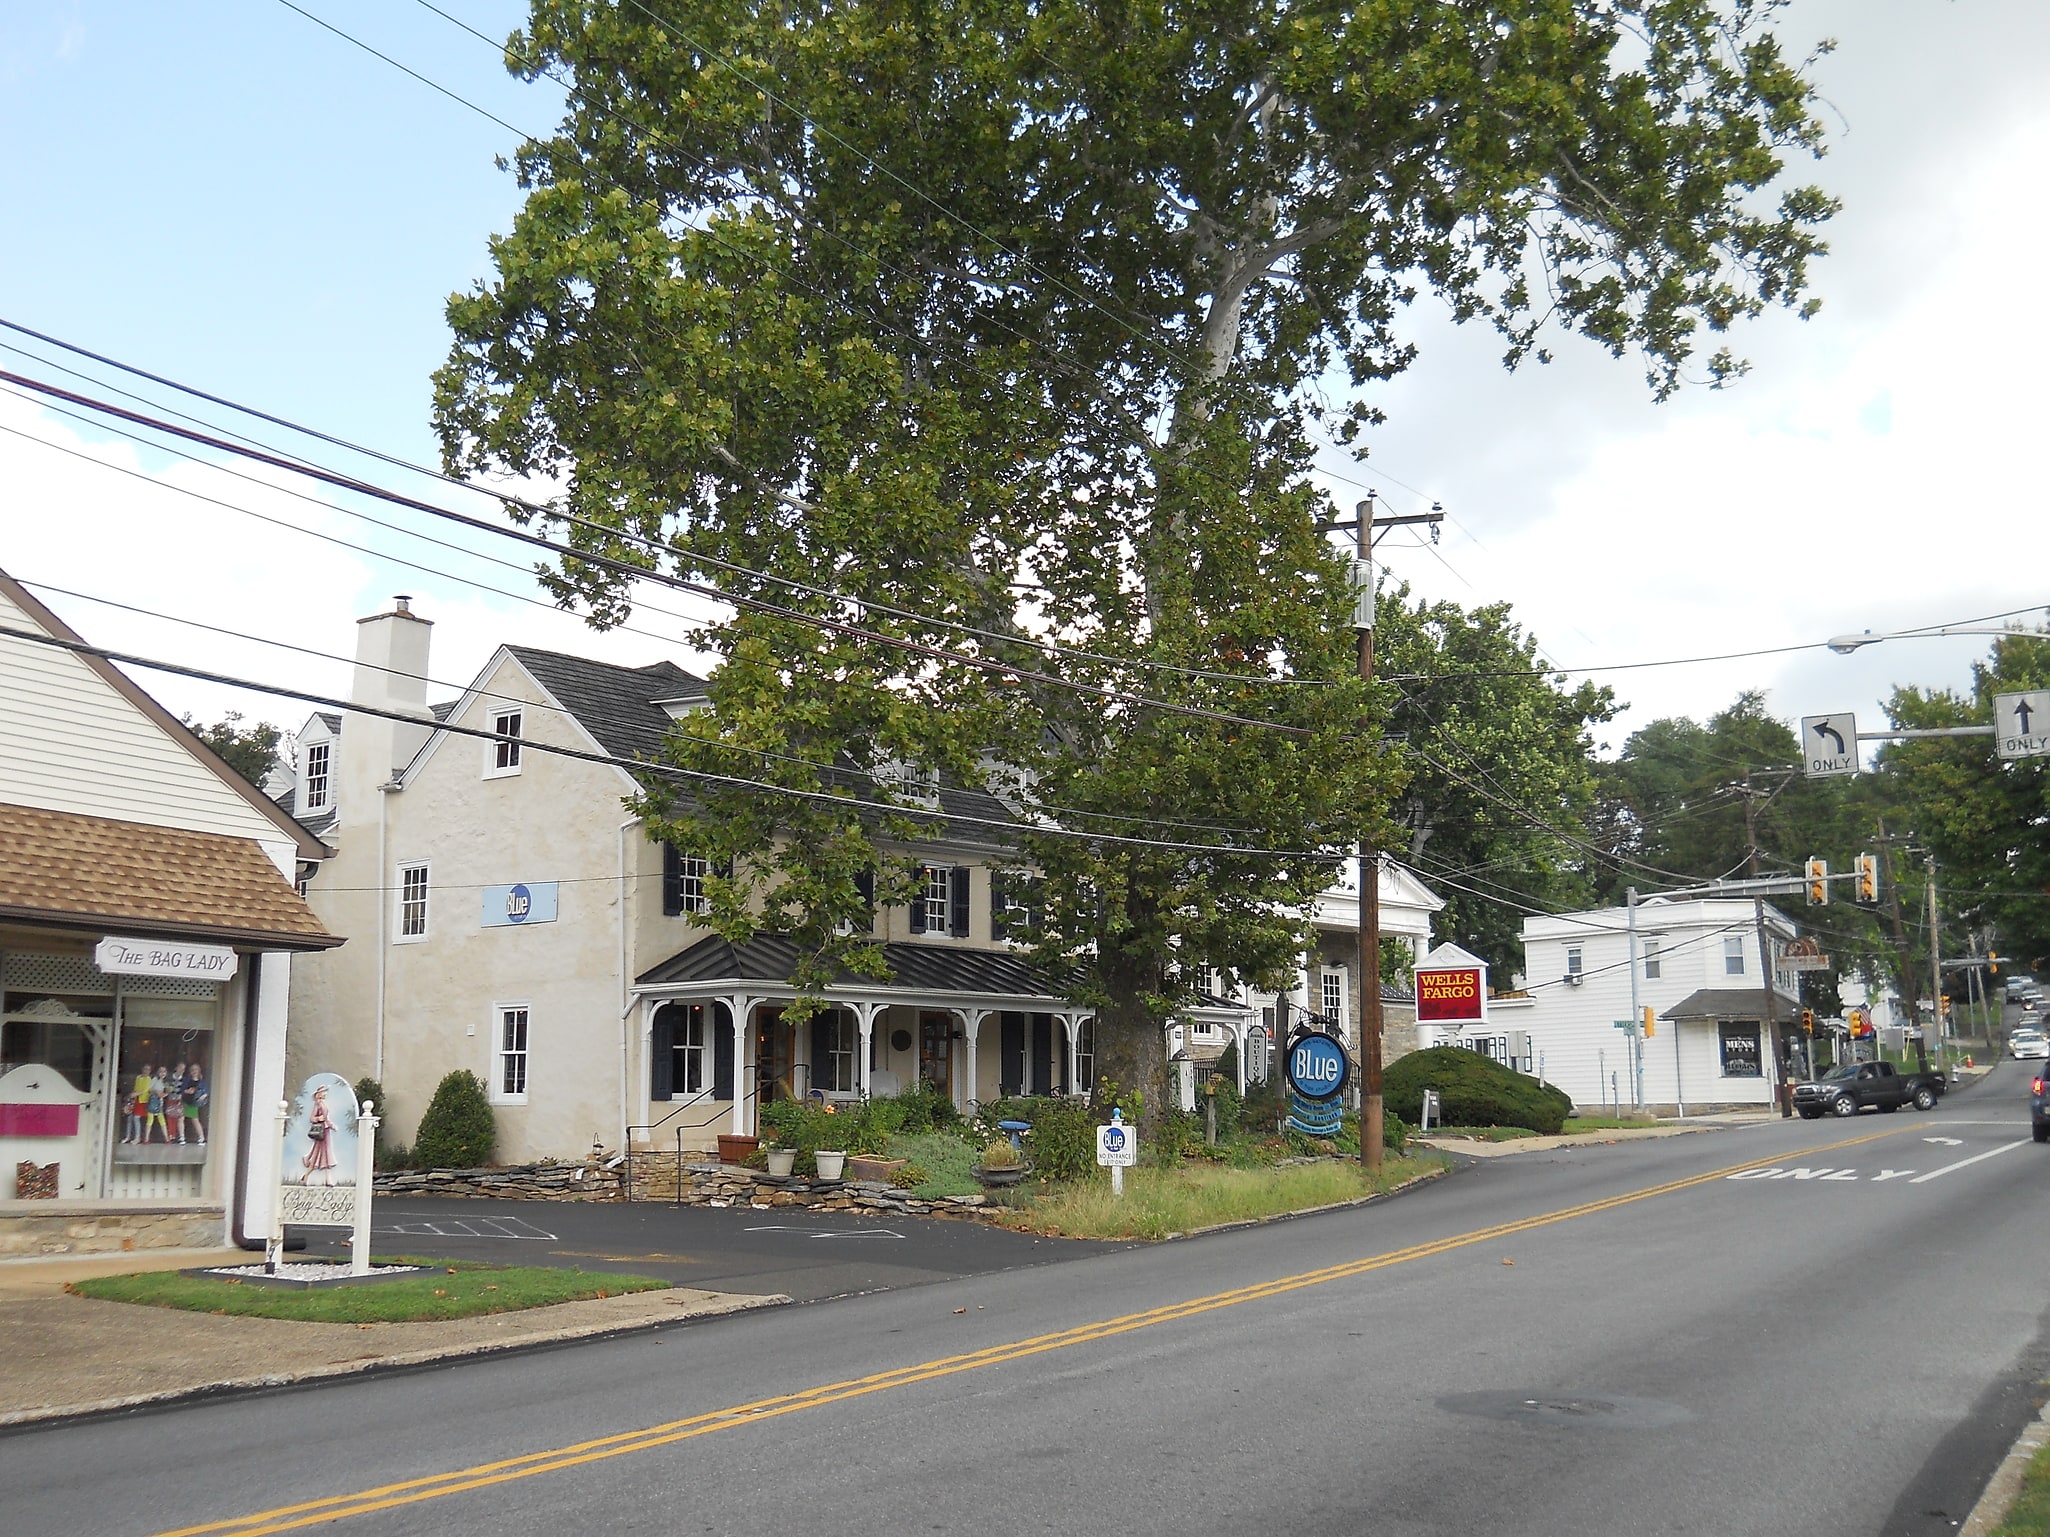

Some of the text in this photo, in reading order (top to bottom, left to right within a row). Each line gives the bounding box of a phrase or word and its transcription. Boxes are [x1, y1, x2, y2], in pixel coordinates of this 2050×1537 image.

[2007, 736, 2048, 752] ONLY
[1812, 756, 1851, 772] ONLY
[150, 950, 182, 967] BAG
[186, 953, 229, 971] LADY
[1420, 973, 1474, 986] WELLS
[1422, 986, 1475, 999] FARGO
[1107, 1152, 1132, 1160] ENTRANCE
[1726, 1167, 1917, 1183] ONLY
[315, 1190, 354, 1222] Lady
